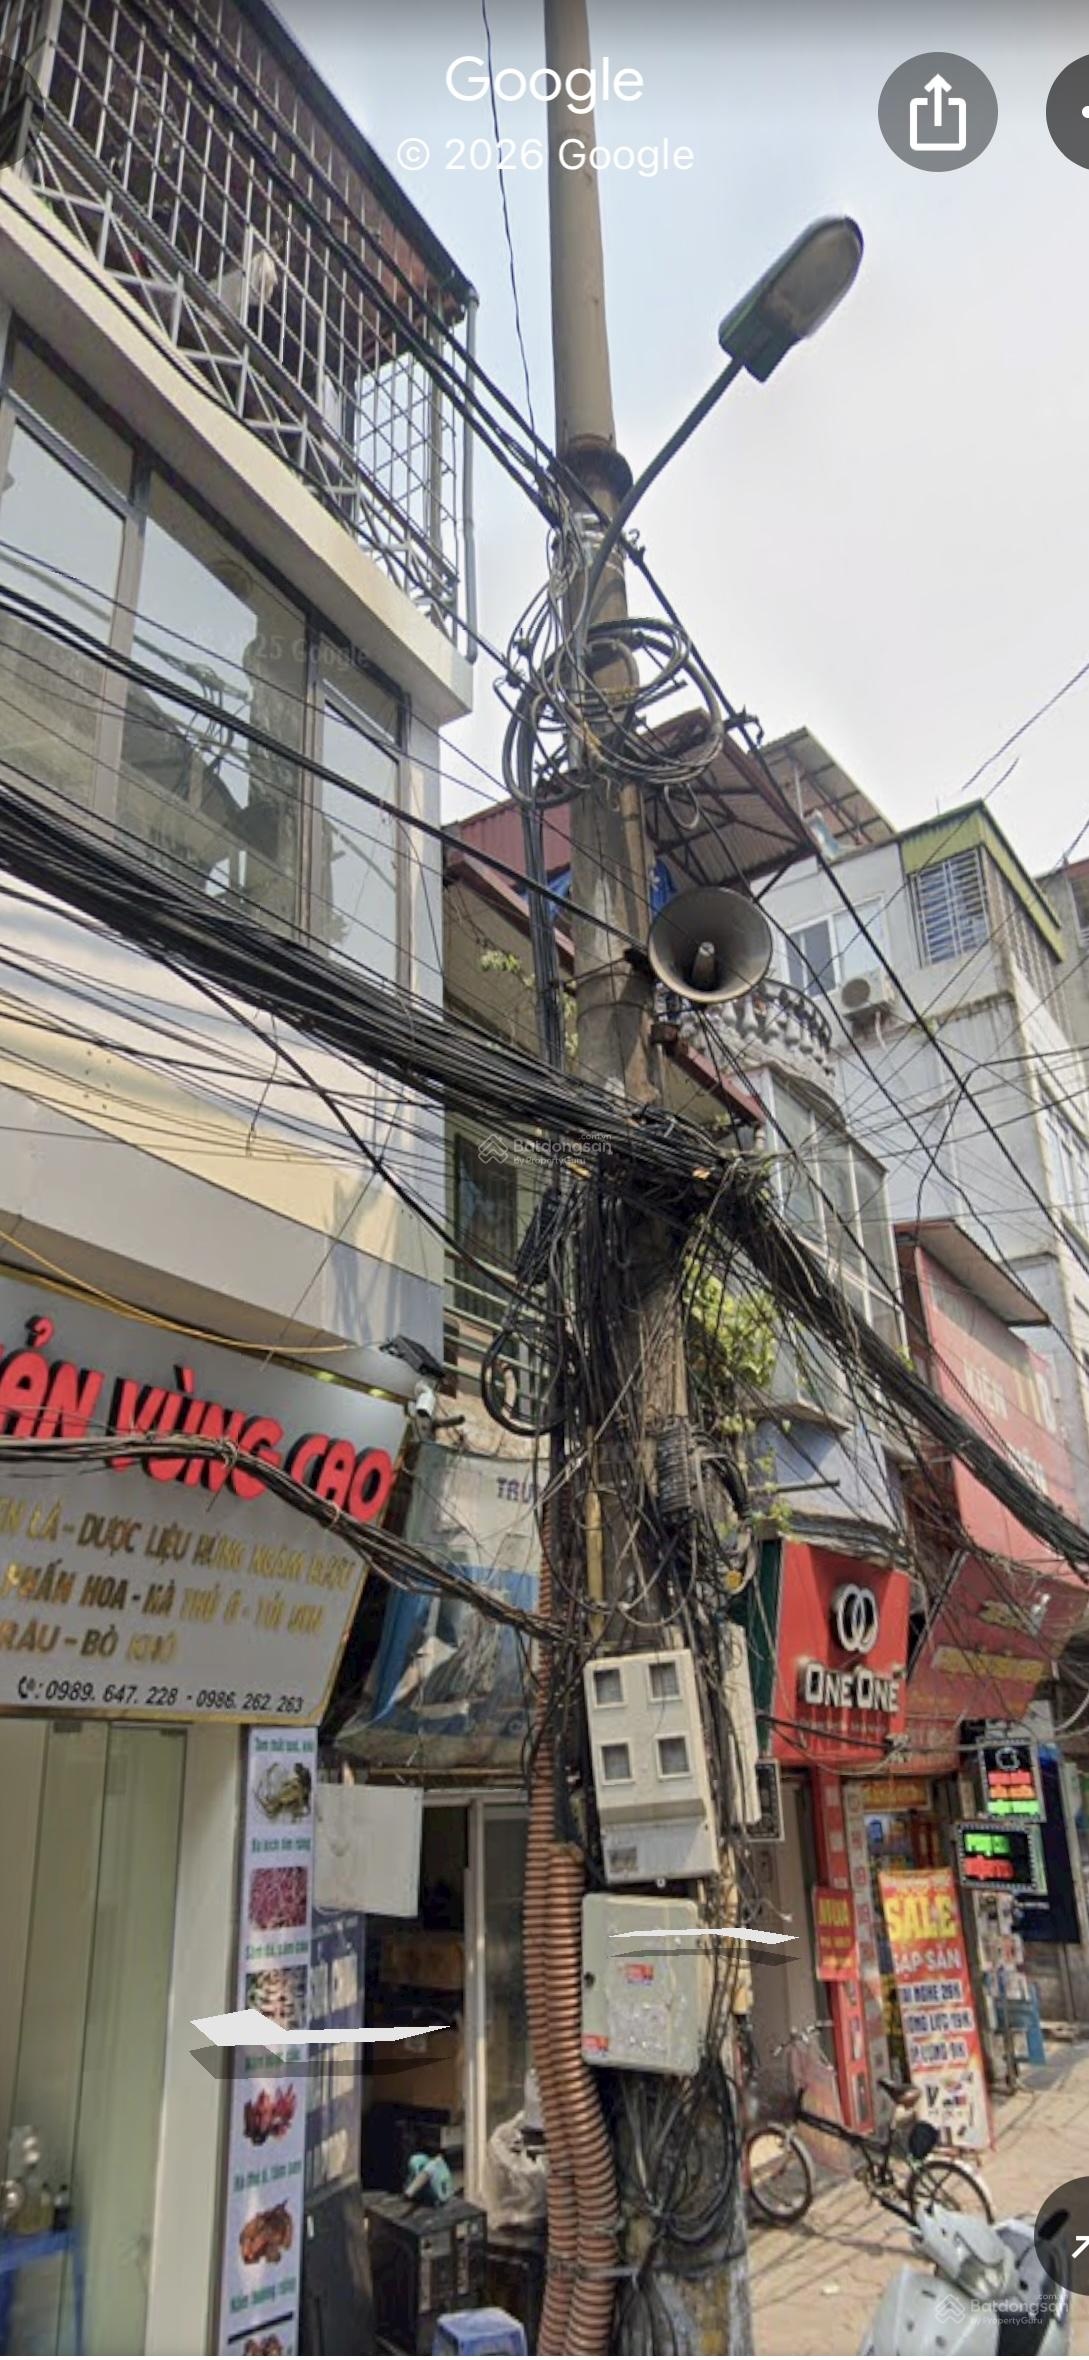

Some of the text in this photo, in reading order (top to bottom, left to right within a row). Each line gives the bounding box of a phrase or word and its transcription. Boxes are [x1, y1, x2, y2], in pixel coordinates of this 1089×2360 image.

[0, 1315, 394, 1523] ẢN VÙNG CAO
[80, 1573, 128, 1611] HOA
[80, 1624, 119, 1658] BÒ
[46, 1680, 95, 1702] 0989.
[103, 1684, 137, 1704] 647.
[146, 1685, 178, 1706] 228
[885, 1895, 956, 1941] SALE
